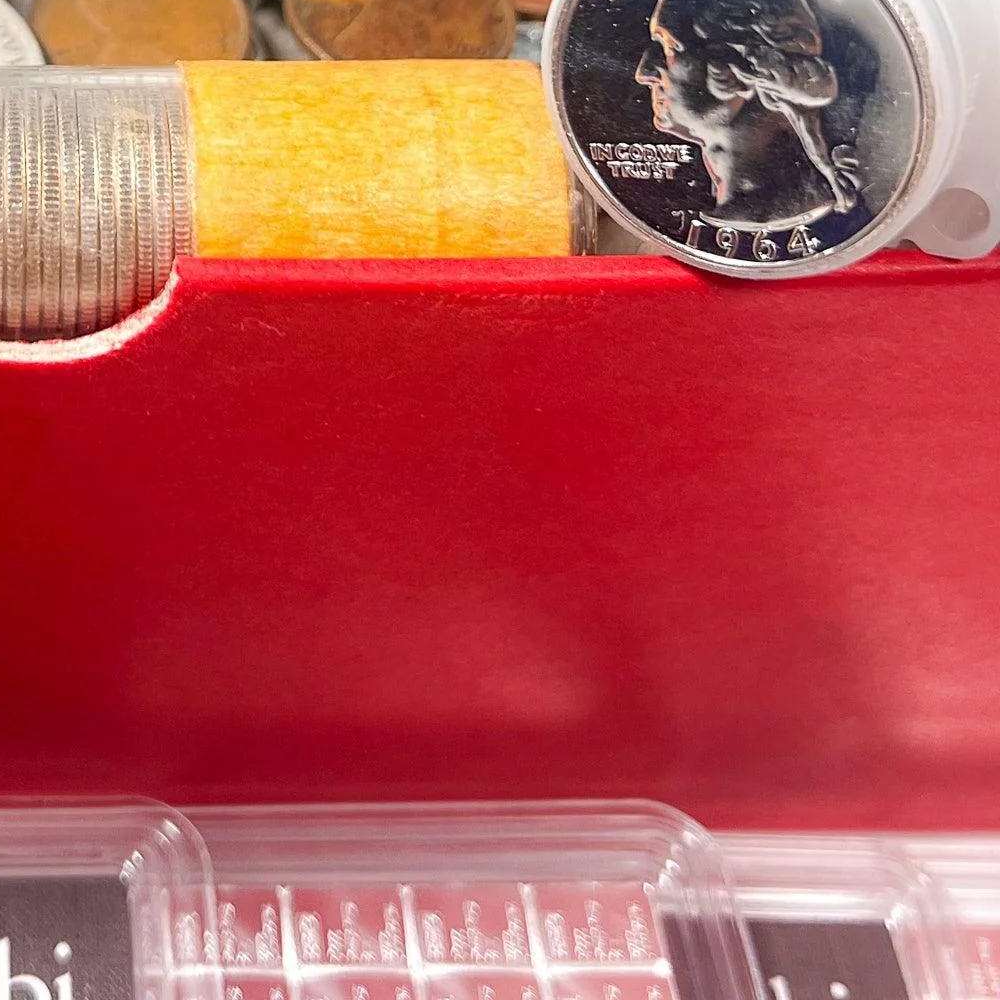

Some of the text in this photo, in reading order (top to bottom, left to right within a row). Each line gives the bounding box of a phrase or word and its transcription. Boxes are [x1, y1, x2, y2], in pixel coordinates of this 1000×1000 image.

[588, 142, 613, 161] IN
[656, 144, 693, 163] WE
[607, 160, 680, 180] TRUST
[685, 219, 821, 262] 1964
